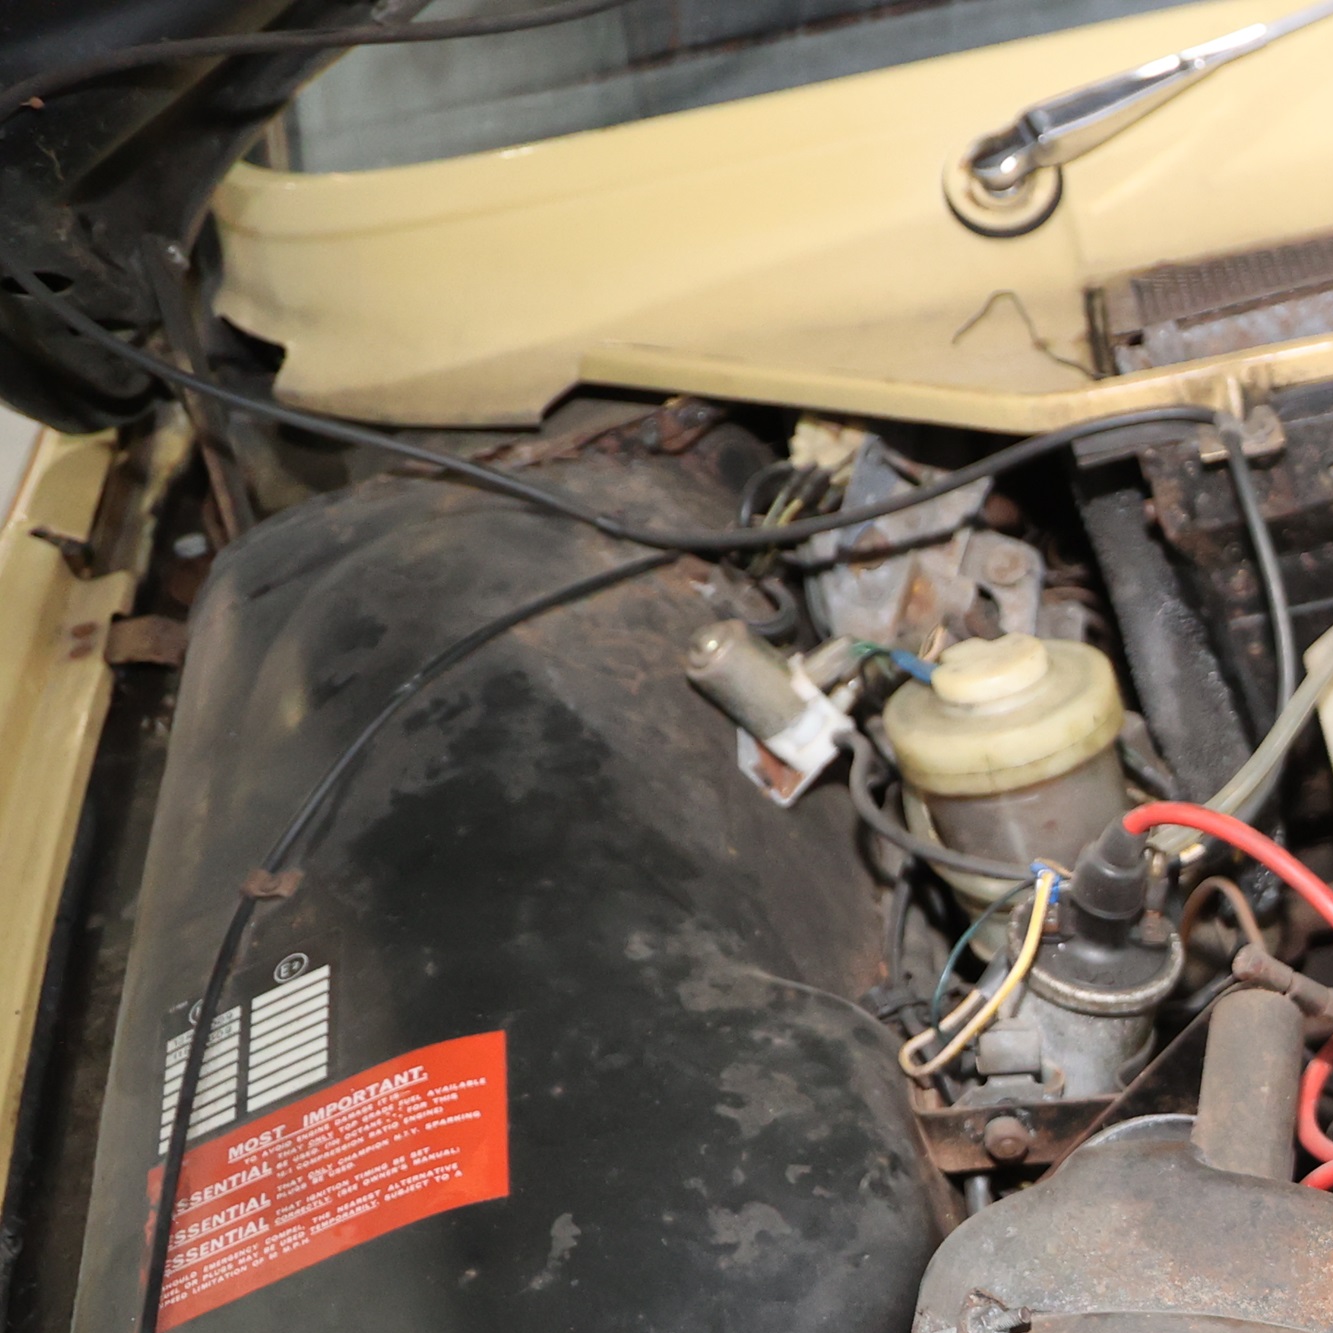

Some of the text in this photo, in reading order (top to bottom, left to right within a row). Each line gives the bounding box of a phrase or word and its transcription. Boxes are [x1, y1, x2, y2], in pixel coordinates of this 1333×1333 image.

[176, 1077, 486, 1214] SSENTIAL THAT ONLY TOP GRADE FUEL AVAILABLE
[228, 1124, 286, 1162] MOST
[244, 1155, 257, 1164] TO
[262, 1141, 292, 1158] AVOID
[296, 1123, 330, 1142] ENGINE
[334, 1104, 373, 1126] DAMAGE
[276, 1160, 288, 1169] BE
[344, 1118, 383, 1140] OCTANE
[407, 1101, 427, 1113] FOR
[432, 1092, 458, 1104] THIS
[295, 1137, 364, 1170] COMPRESSION
[368, 1121, 399, 1138] RATIO
[168, 1192, 271, 1250] SSENTIAL
[277, 1176, 303, 1191] THAT
[307, 1163, 334, 1180] ONLY
[337, 1138, 390, 1165] CHAMPION
[425, 1110, 481, 1130] SPARKING
[276, 1200, 302, 1216] THAT
[306, 1180, 350, 1201] IGNITION
[354, 1163, 389, 1181] TIMING
[392, 1156, 405, 1165] BE
[410, 1146, 430, 1159] SET
[276, 1182, 307, 1200] PLUGS
[312, 1175, 324, 1185] BE
[185, 1279, 198, 1290] OR
[203, 1264, 233, 1281] PLUGS
[238, 1252, 259, 1265] MAY
[263, 1244, 275, 1254] BE
[280, 1231, 305, 1247] USED
[384, 1179, 429, 1201] SUBJECT
[434, 1173, 450, 1182] TO
[203, 1243, 259, 1273] EMERGENCY
[312, 1211, 331, 1224] THE
[337, 1189, 381, 1213] NEAREST
[387, 1162, 458, 1191] ALTERNATIVE
[192, 1265, 247, 1294] LIMITATION
[252, 1257, 264, 1267] OF
